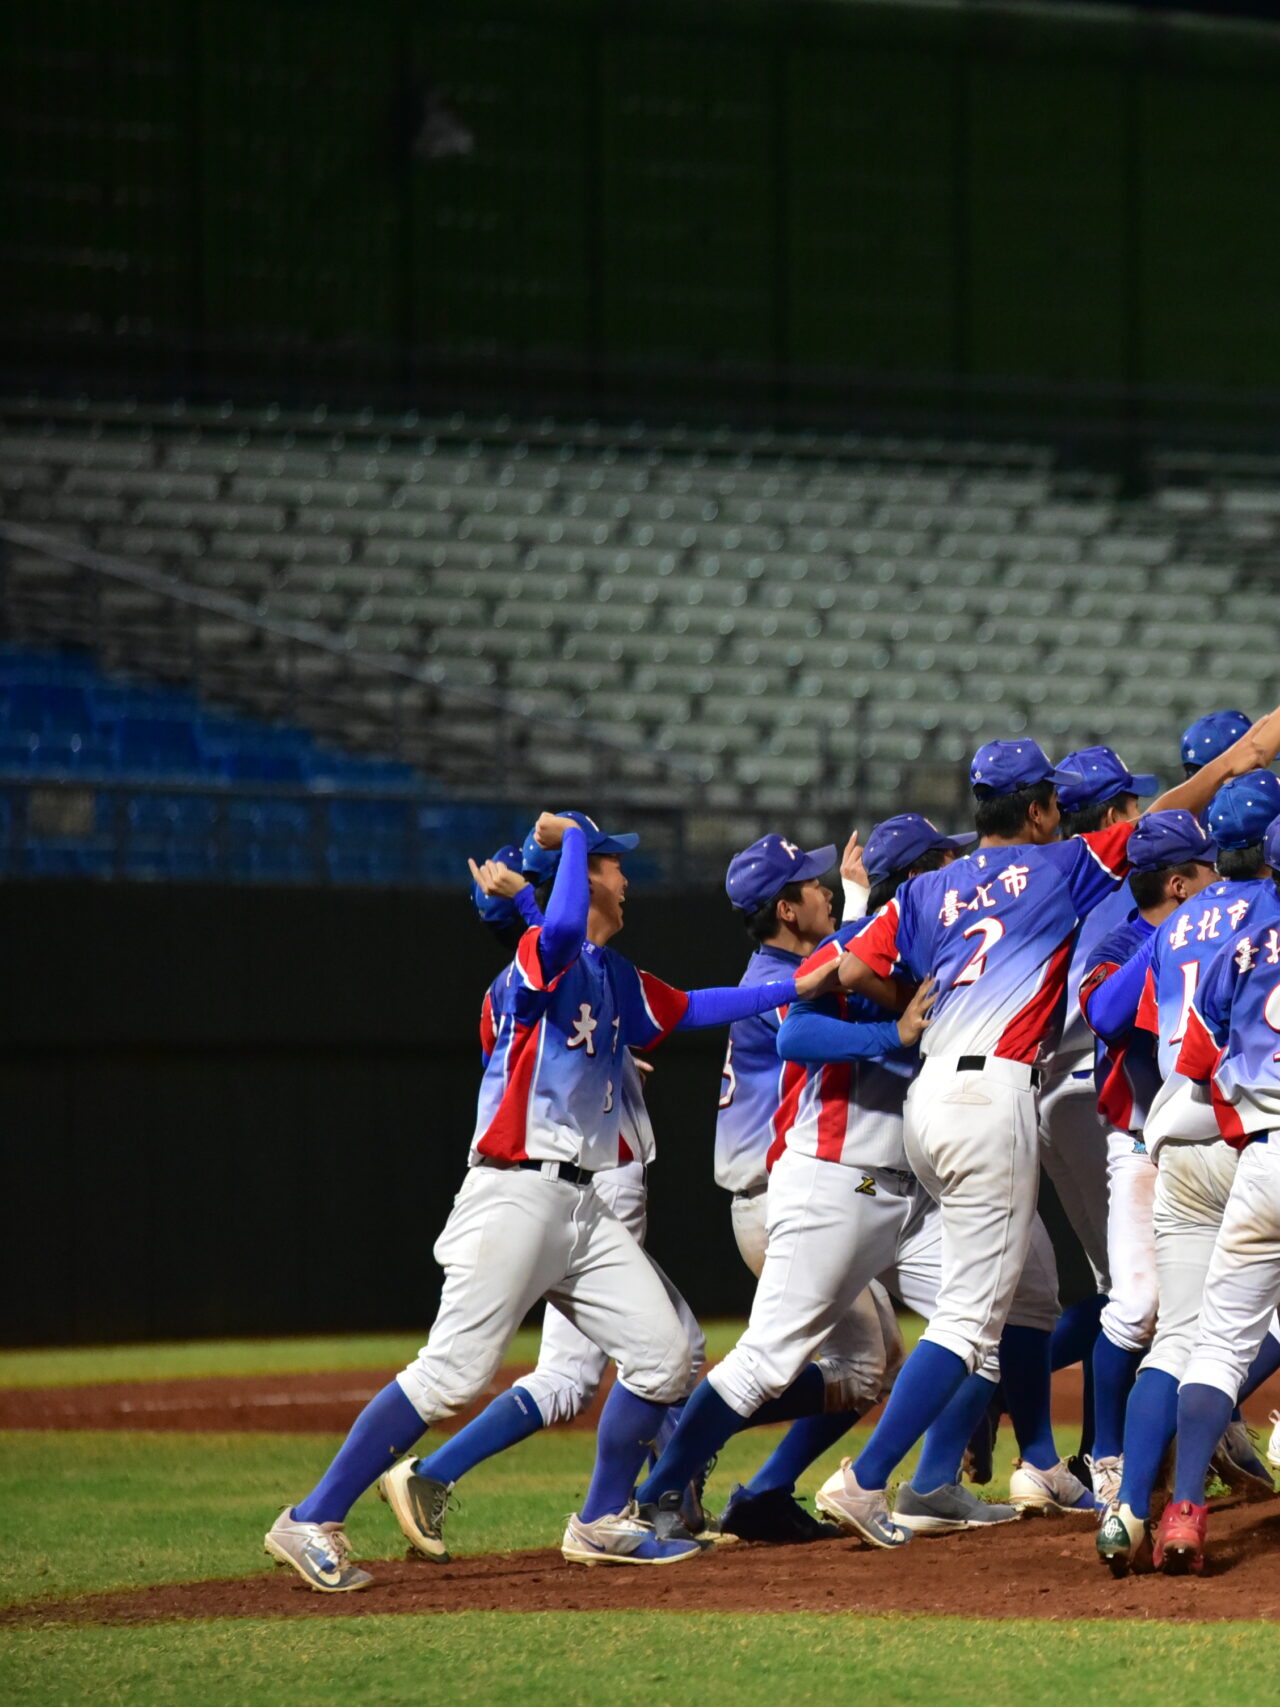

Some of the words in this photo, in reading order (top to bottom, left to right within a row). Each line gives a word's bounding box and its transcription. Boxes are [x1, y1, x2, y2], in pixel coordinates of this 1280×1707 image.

[938, 864, 1030, 928] 臺北市
[1168, 898, 1250, 951] 臺北市
[950, 915, 1006, 989] 2
